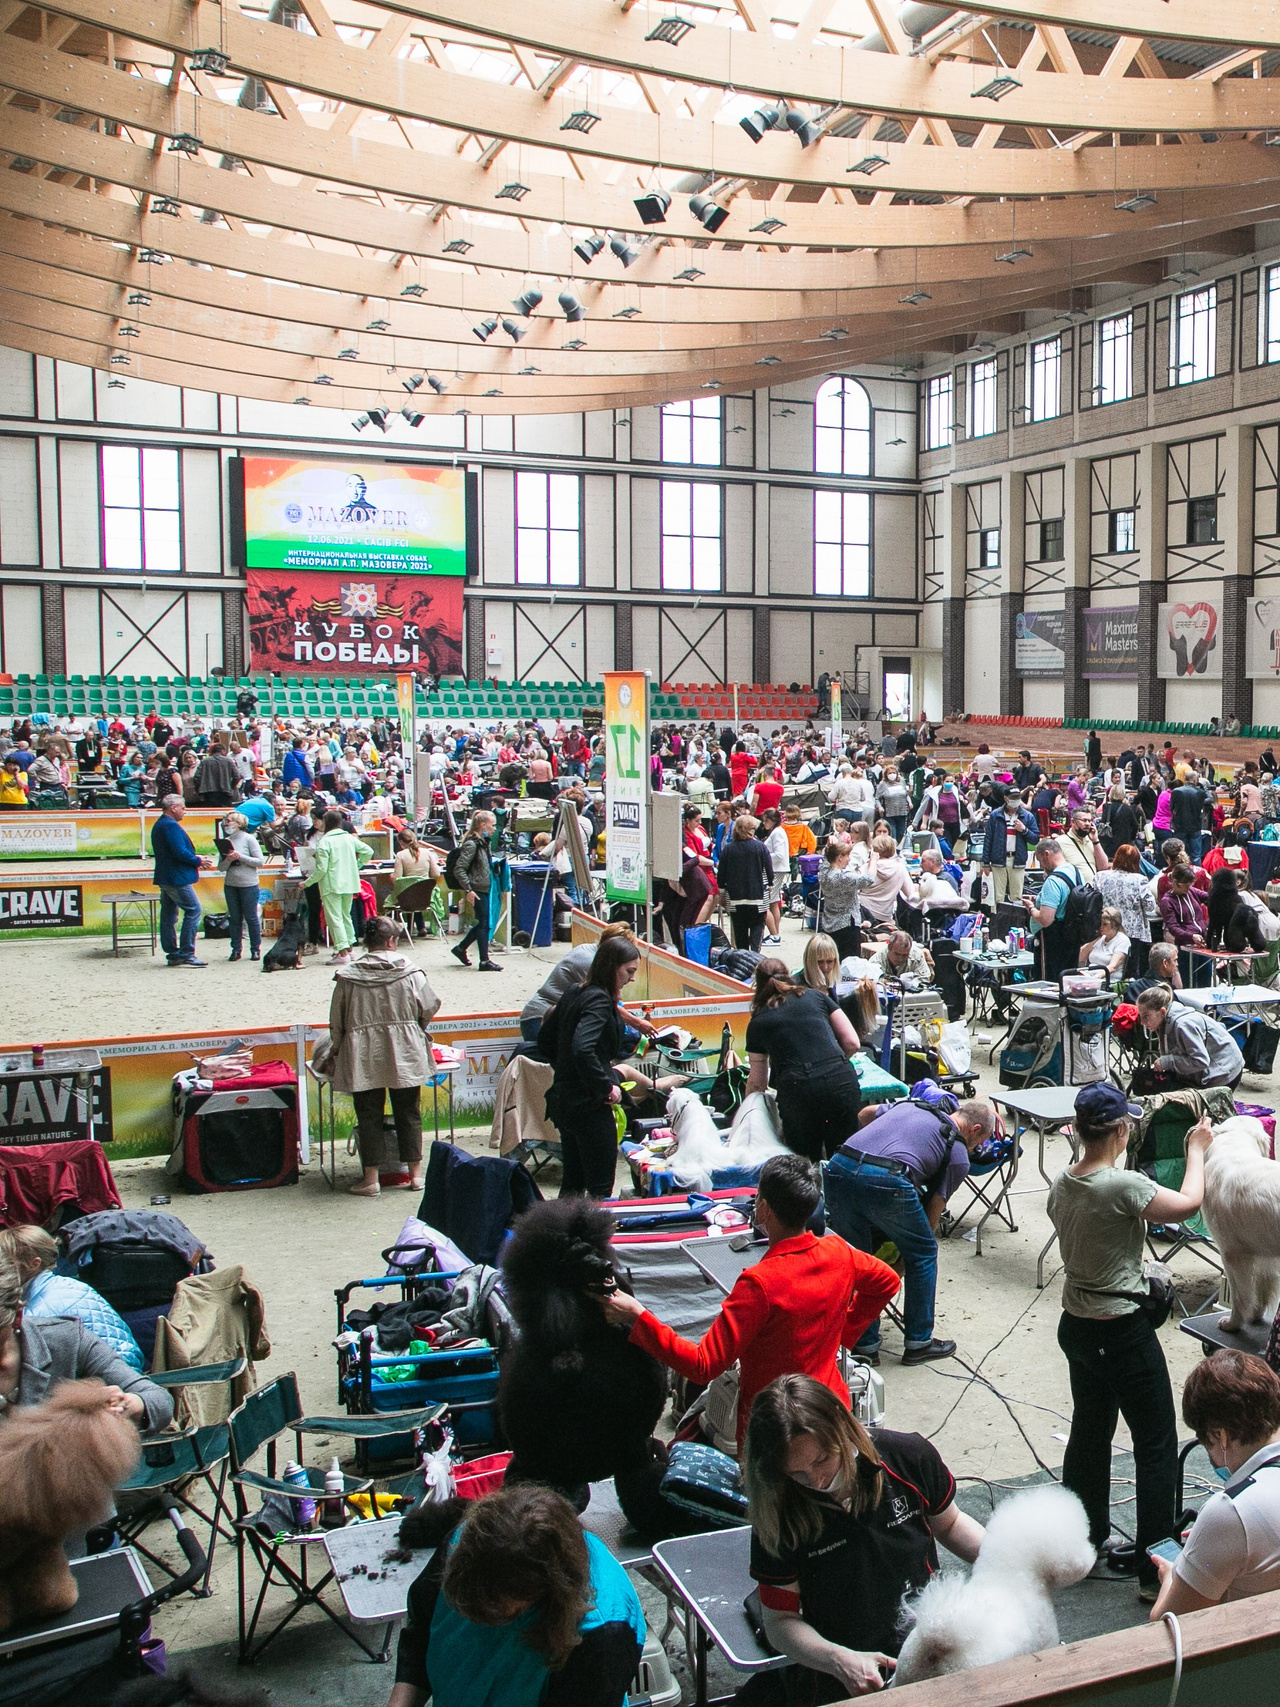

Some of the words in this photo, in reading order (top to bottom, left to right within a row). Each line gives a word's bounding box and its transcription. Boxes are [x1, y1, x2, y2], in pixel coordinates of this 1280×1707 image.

[307, 505, 408, 526] MAZOVER
[308, 535, 354, 545] 12.06.2021
[364, 537, 392, 547] CACIB
[394, 539, 409, 548] FCI
[288, 549, 367, 559] ИНТЕРНАЦИОНАЛЬНАЯ
[368, 553, 404, 562] ВЫСТАВКА
[405, 554, 428, 562] СОБАК
[283, 557, 340, 568] «МЕМОРИАЛ
[341, 559, 360, 568] А.П.
[361, 560, 408, 571] МАЗОВЕРА
[410, 562, 433, 572] 2021»
[294, 621, 419, 640] КУБОК
[1104, 621, 1138, 636] Maxima
[1104, 637, 1138, 651] Masters
[294, 641, 419, 664] ПОБЕДЫ
[1, 829, 73, 838] MAZOVER
[0, 889, 79, 919] CRAVE
[663, 1008, 700, 1016] МАЗОВЕРА
[100, 1045, 157, 1055] «МЕМОРИАЛ
[180, 1040, 227, 1049] МАЗОВЕРА
[0, 1077, 103, 1126] AVE
[16, 1132, 39, 1142] THEIR
[40, 1130, 71, 1140] NATURE
